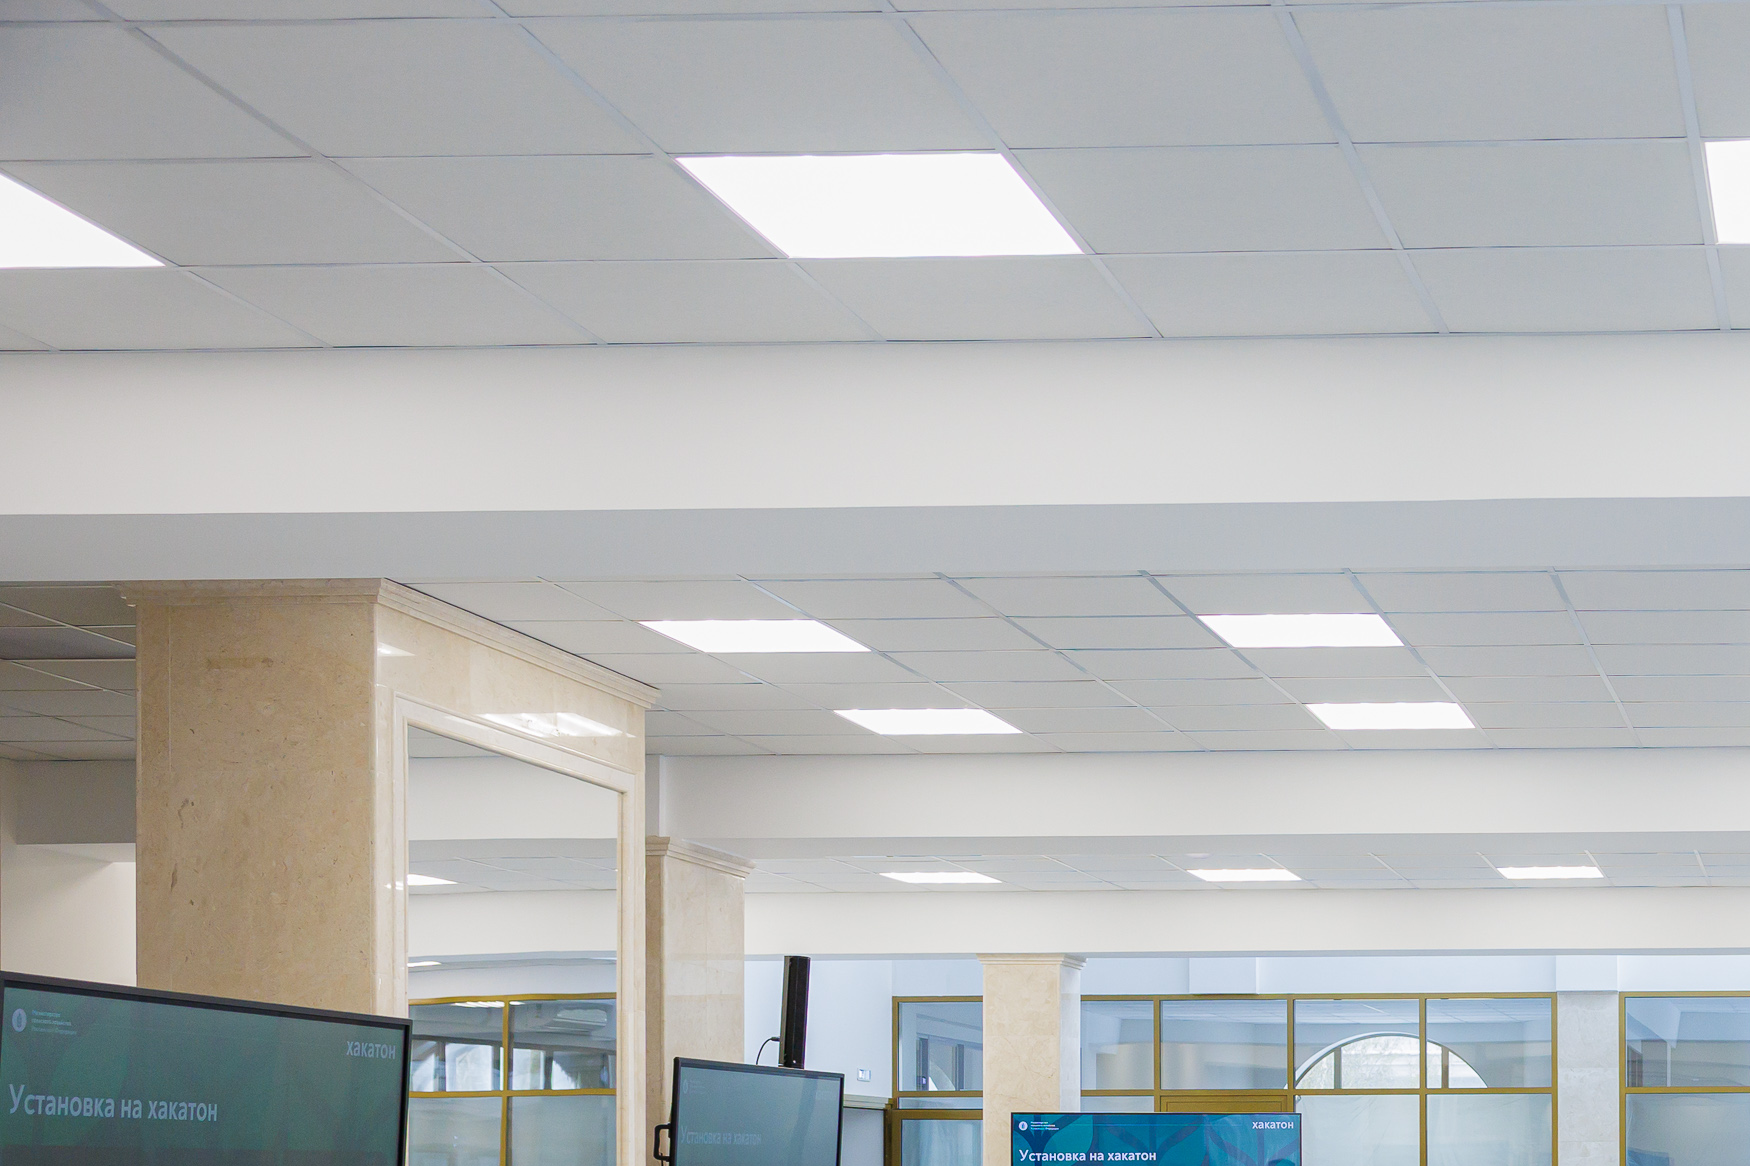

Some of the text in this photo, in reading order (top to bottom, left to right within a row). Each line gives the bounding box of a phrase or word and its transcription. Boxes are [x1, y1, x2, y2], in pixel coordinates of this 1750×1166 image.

[346, 1041, 396, 1060] хакатон
[9, 1084, 218, 1122] Установка на хакатон
[1252, 1121, 1294, 1129] хакатон
[680, 1126, 721, 1145] Установка
[1018, 1149, 1157, 1162] Установка на хакатон
